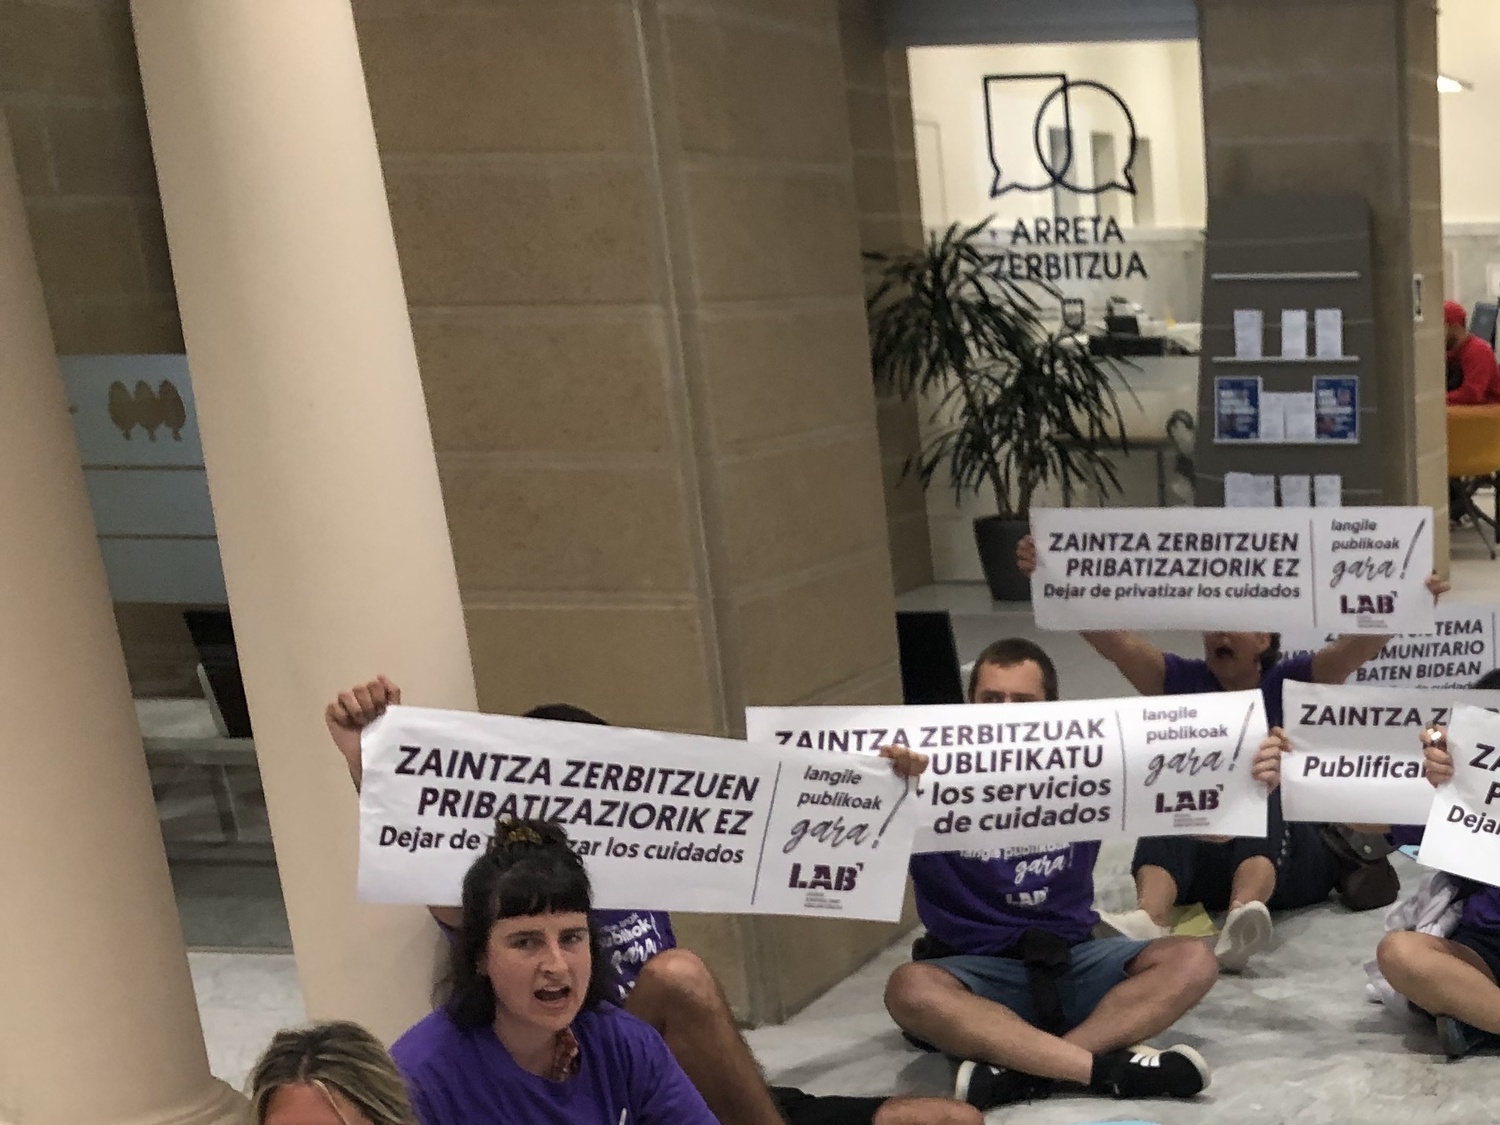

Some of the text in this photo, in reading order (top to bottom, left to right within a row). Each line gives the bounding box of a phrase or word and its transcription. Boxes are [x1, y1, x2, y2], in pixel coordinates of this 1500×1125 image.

[1011, 216, 1125, 246] ARRETA
[990, 251, 1149, 283] ZERBITZUA
[1331, 519, 1377, 533] langile
[1048, 532, 1299, 552] ZAINTZA ZERBITZUEN
[1331, 537, 1400, 552] publikoak
[1066, 557, 1300, 577] PRIBATIZAZIORIK EZ
[1044, 582, 1300, 600] Dejar de privatizar los cuidados
[1339, 590, 1399, 615] LAB
[1356, 661, 1482, 682] BATEN BIDEAN
[1142, 708, 1198, 723] langile
[1299, 704, 1423, 727] ZAINTZA
[919, 718, 1106, 748] ZERBITZUAK
[1145, 724, 1229, 743] publikoak
[395, 745, 760, 802] ZAINTZA ZERBITZUEN
[931, 745, 1104, 776] UBLIFIKATU
[803, 765, 862, 785] langile
[797, 790, 882, 810] publikoak
[931, 776, 1112, 806] los servicios
[1154, 784, 1225, 815] LAB
[417, 787, 753, 836] PRIBATIZAZIORIK EZ
[933, 803, 1111, 834] de cuidados
[379, 825, 446, 852] Dejar
[449, 828, 481, 851] de
[605, 837, 639, 858] los
[643, 842, 744, 865] cuidados
[788, 862, 864, 892] LAB
